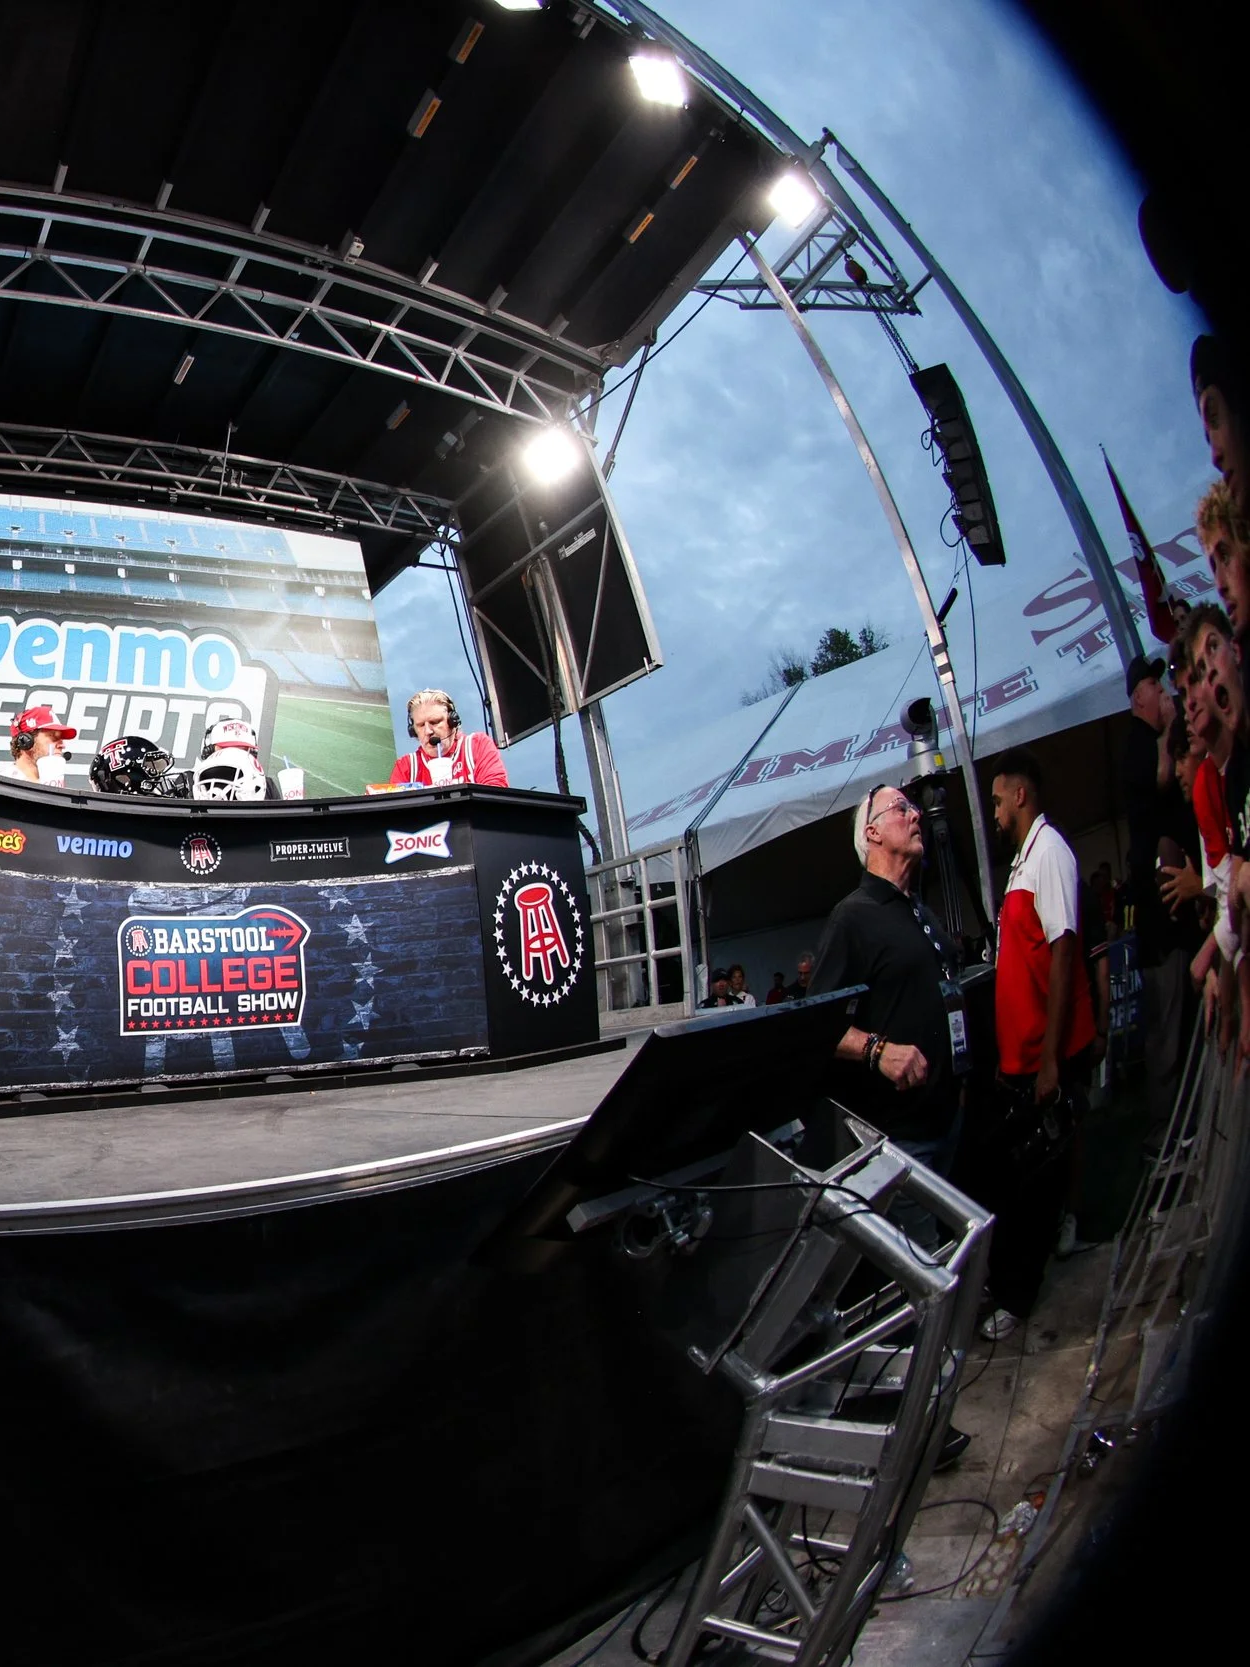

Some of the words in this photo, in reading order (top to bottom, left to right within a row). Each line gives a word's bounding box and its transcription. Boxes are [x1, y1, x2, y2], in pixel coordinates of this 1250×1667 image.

[56, 835, 133, 858] venmo
[393, 834, 442, 851] SONIC
[153, 926, 275, 954] BARSTOOL
[126, 955, 299, 995] COLLEGE
[127, 997, 229, 1017] FOOTBALL
[237, 992, 298, 1012] SHOW
